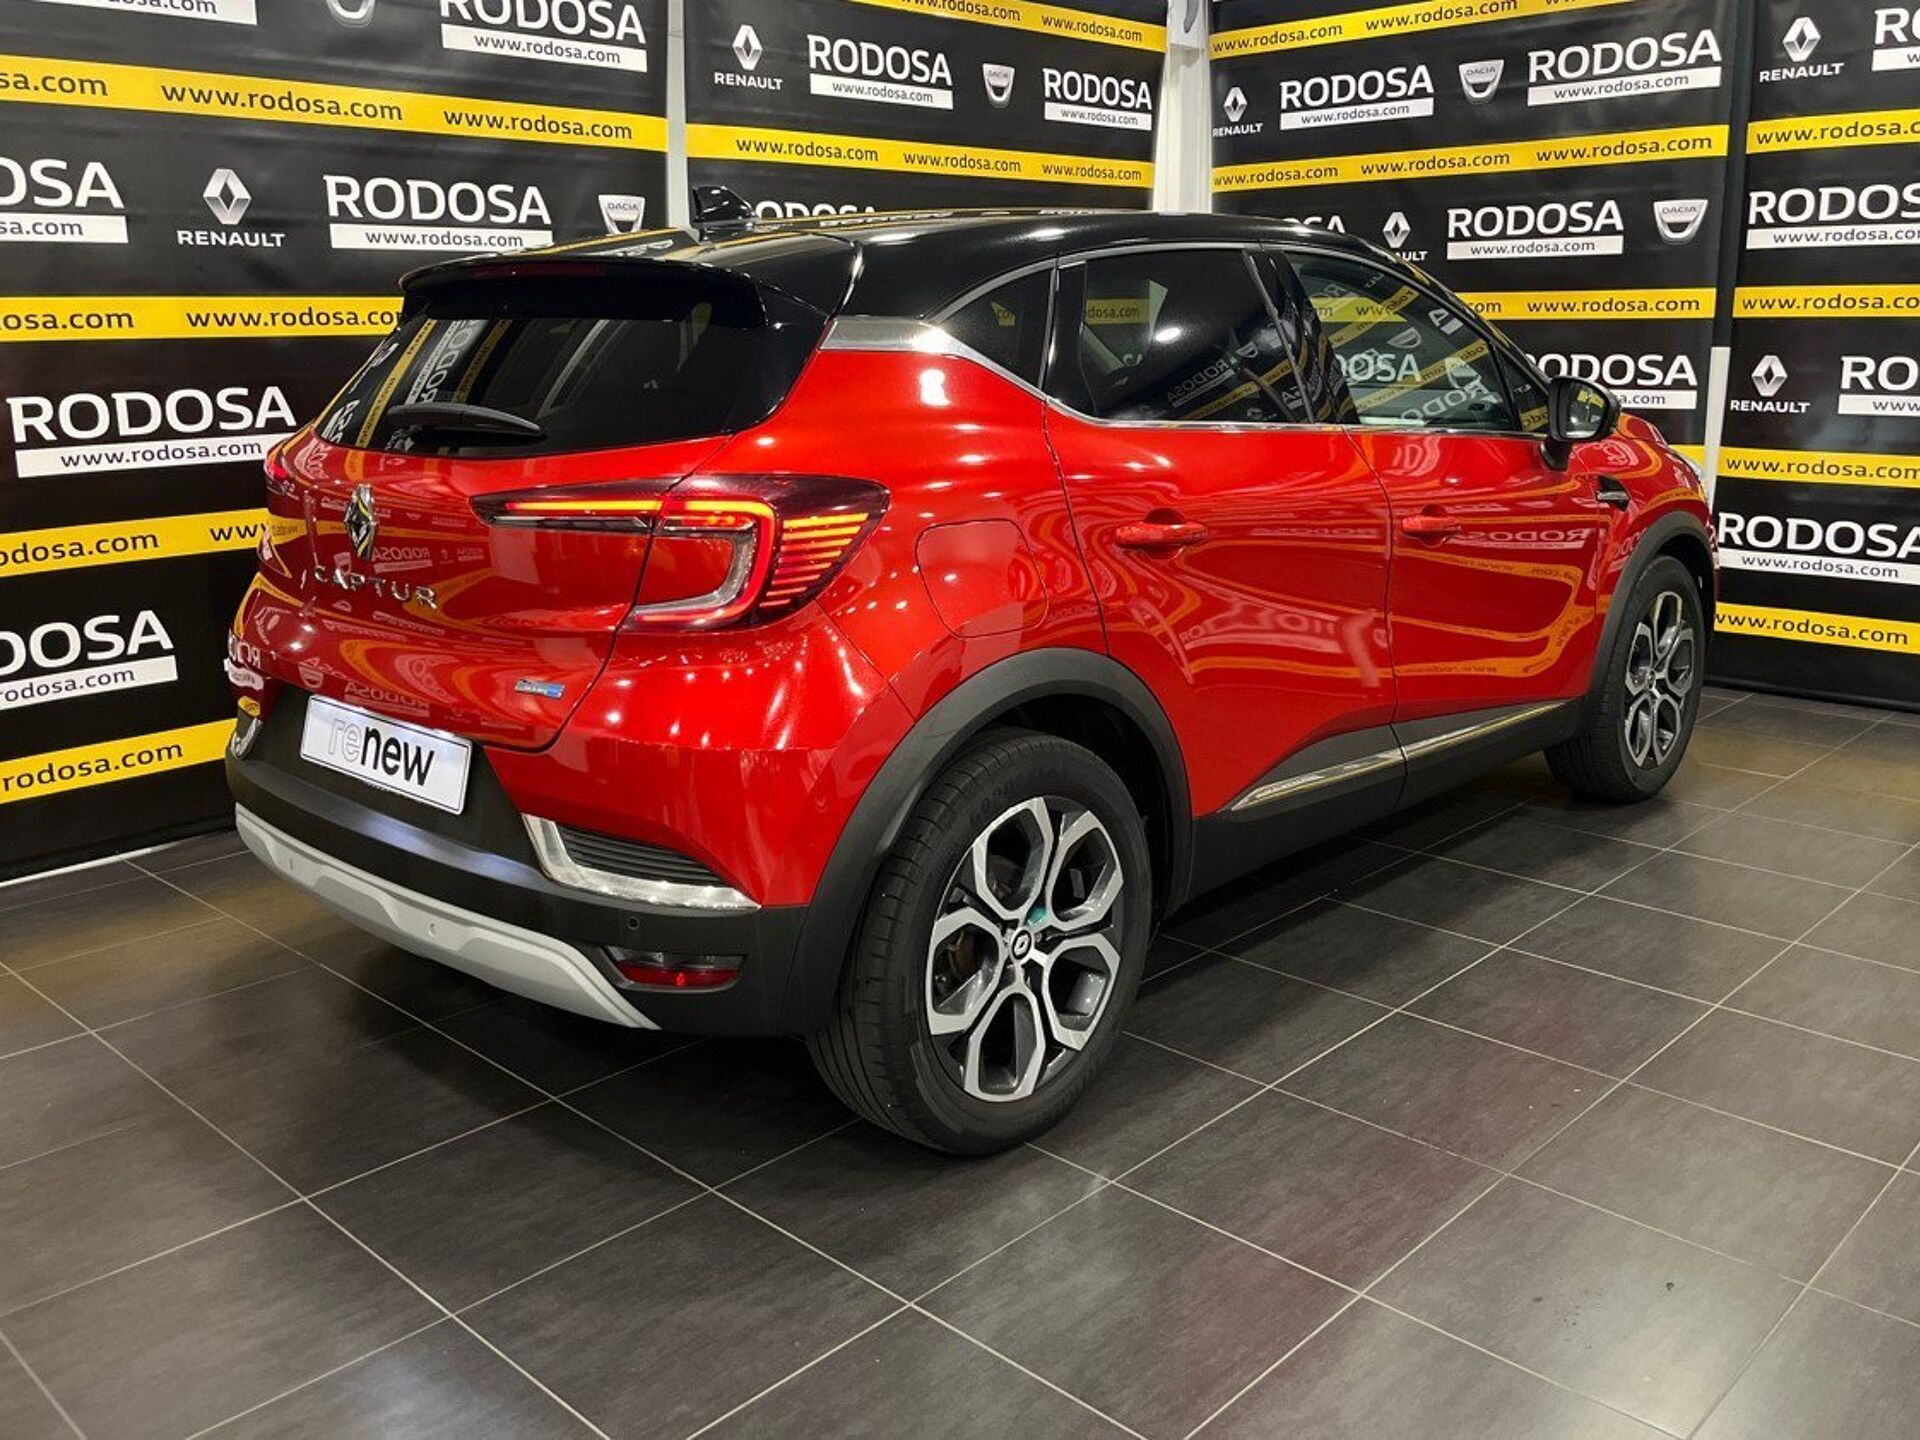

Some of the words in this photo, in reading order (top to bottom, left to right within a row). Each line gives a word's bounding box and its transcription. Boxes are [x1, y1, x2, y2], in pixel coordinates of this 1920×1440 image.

[1366, 0, 1518, 31] www.rodosa.com
[1041, 14, 1142, 42] www.rodosa.com
[1213, 25, 1343, 52] www.rodosa.com
[474, 34, 621, 64] www.rodosa.com
[807, 34, 953, 86] RODOSA
[1528, 29, 1722, 82] RODOSA
[714, 72, 783, 90] RENAULT
[1465, 66, 1497, 76] DACIA
[1759, 63, 1845, 82] RENAULT
[832, 80, 934, 103] www.rodosa.com
[1043, 68, 1153, 110] RODOSA
[1280, 65, 1434, 110] RODOSA
[1554, 74, 1690, 99] www.rodosa.com
[162, 84, 403, 122] www.rodosa.com
[1301, 104, 1410, 125] www.rodosa.com
[444, 110, 633, 139] www.rodosa.com
[1060, 108, 1138, 126] www.rodosa.com
[1213, 122, 1263, 137] RENAULT
[736, 139, 879, 162] www.rodosa.com
[1536, 135, 1712, 162] www.rodosa.com
[904, 151, 1021, 172] www.rodosa.com
[1042, 163, 1142, 181] www.rodosa.com
[1361, 150, 1510, 174] www.rodosa.com
[1213, 165, 1338, 187] www.rodosa.com
[323, 175, 551, 224] RODOSA
[1661, 206, 1698, 215] DACIA
[1447, 200, 1624, 238] RODOSA
[178, 231, 285, 248] RENAULT
[365, 230, 523, 247] www.rodosa.com
[1470, 240, 1596, 255] www.rodosa.com
[1773, 228, 1920, 243] www.rodosa.co
[1526, 297, 1700, 313] www.rodosa.com
[6, 386, 297, 443] RODOSA
[1730, 399, 1810, 413] RENAULT
[61, 439, 262, 468] www.rodosa.com
[1742, 554, 1899, 578] www.rodosa.com
[329, 717, 435, 786] renew
[3, 742, 183, 792] rodosa.com
